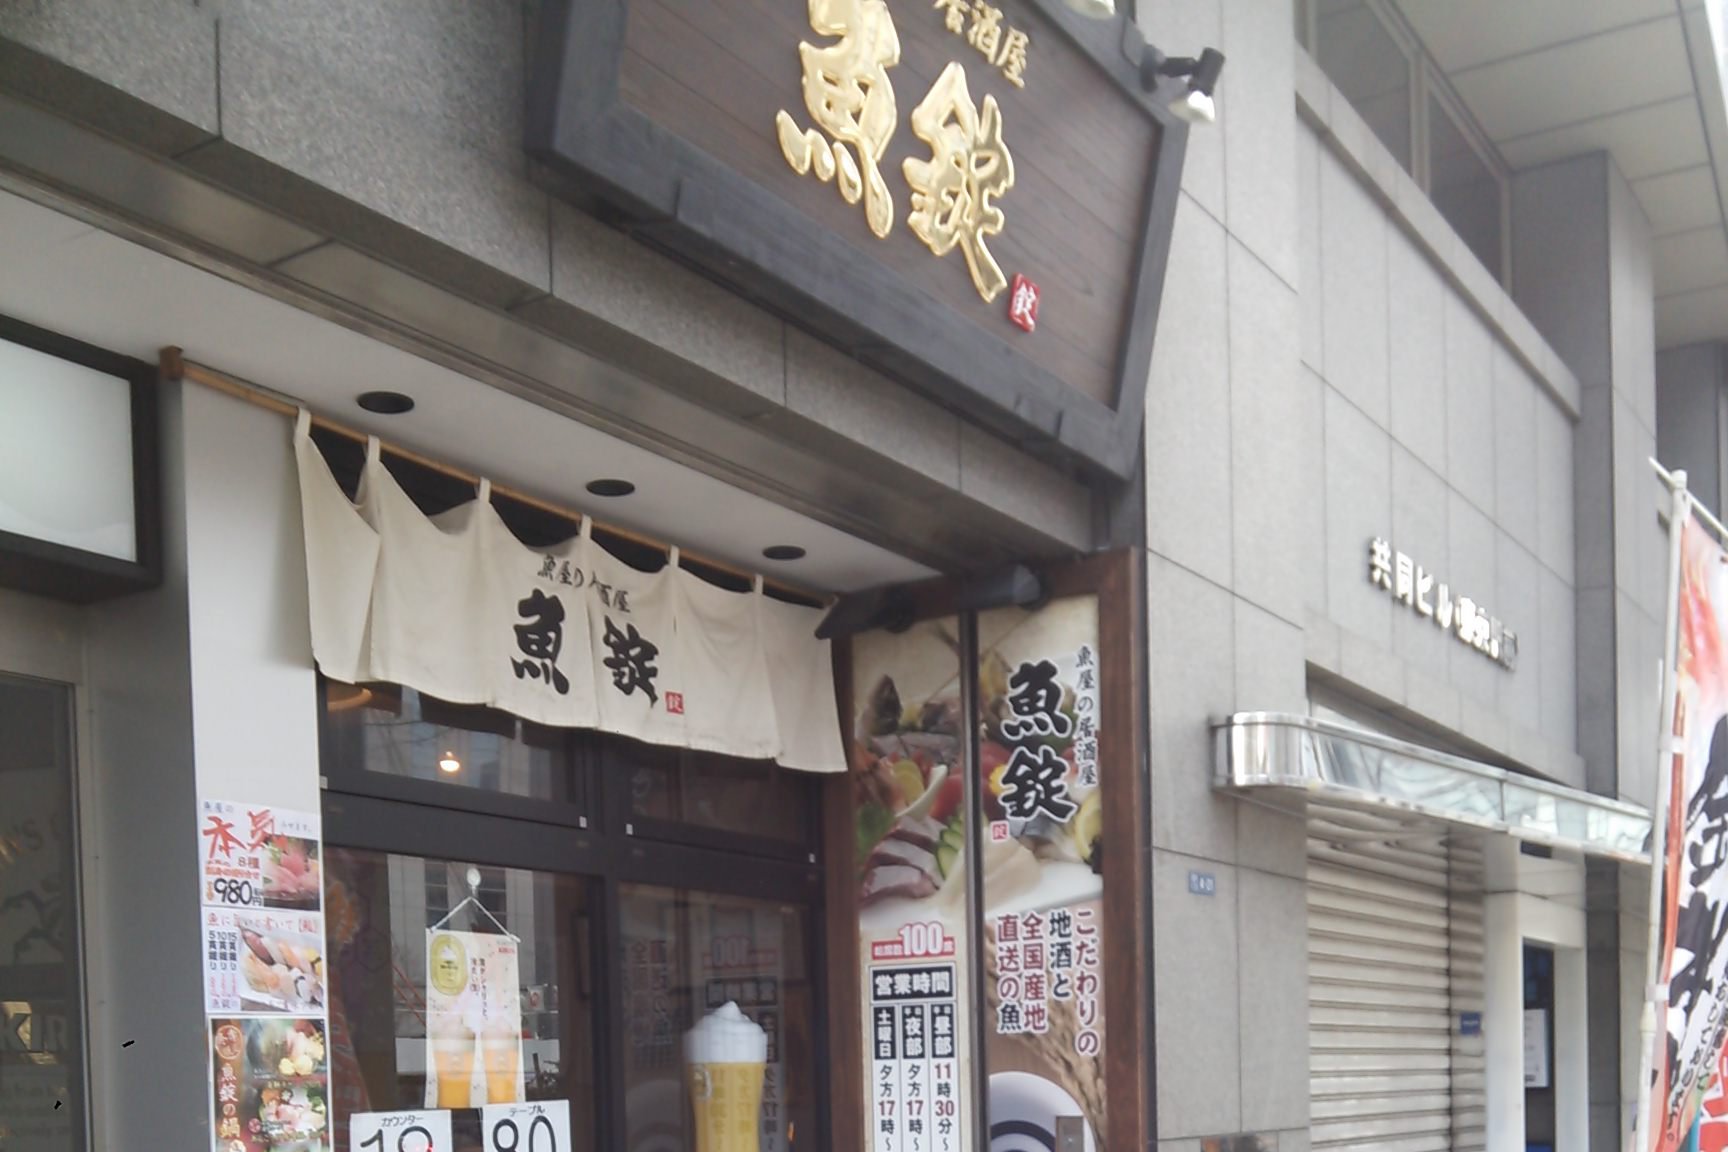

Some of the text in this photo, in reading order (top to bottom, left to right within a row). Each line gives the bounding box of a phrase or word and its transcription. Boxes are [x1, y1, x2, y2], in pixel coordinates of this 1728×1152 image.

[875, 970, 951, 997] 営業時間
[998, 914, 1022, 1031] 直送の魚
[1022, 913, 1046, 1031] 全国産地
[1049, 911, 1072, 998] 地酒と
[1076, 910, 1098, 1054] こだわりの
[877, 1008, 893, 1058] 土曜日
[509, 1104, 546, 1116] テーブル
